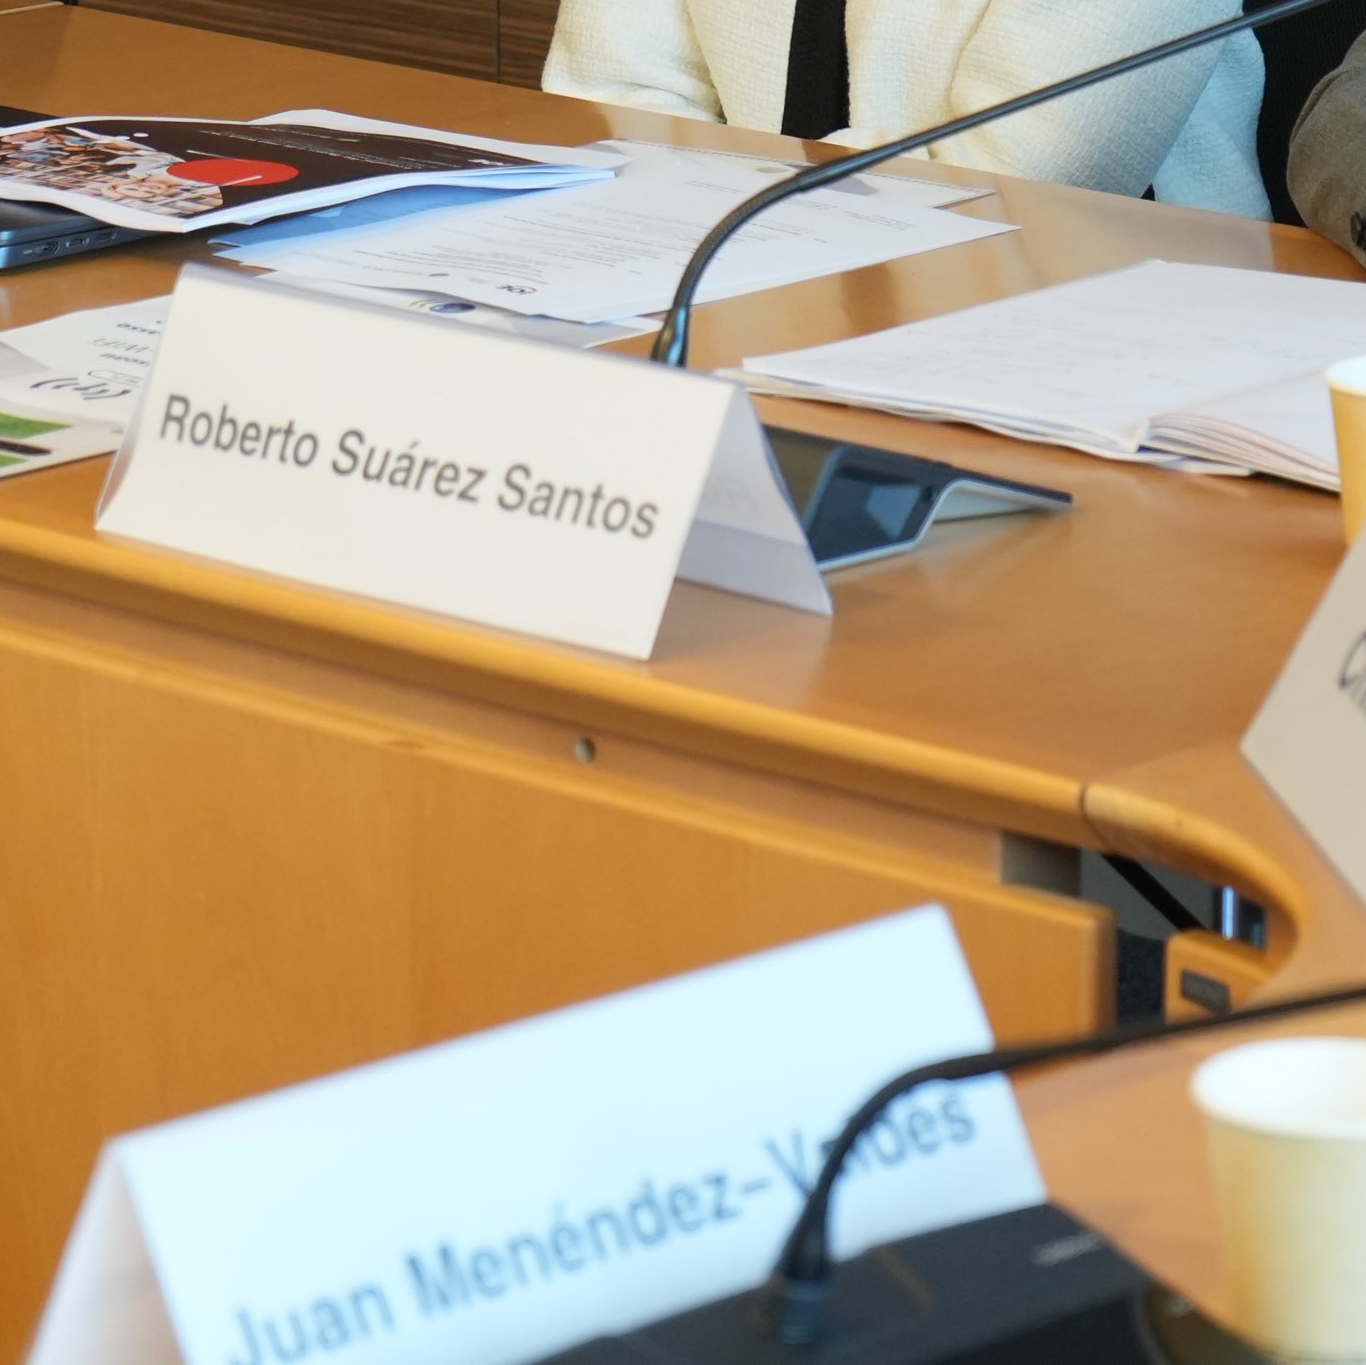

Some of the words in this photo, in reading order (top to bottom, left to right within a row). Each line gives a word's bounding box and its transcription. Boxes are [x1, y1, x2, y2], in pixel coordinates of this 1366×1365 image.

[158, 393, 321, 468] Roberto
[330, 428, 489, 504] Suárez
[496, 463, 660, 540] Santos
[227, 1279, 395, 1365] Juan
